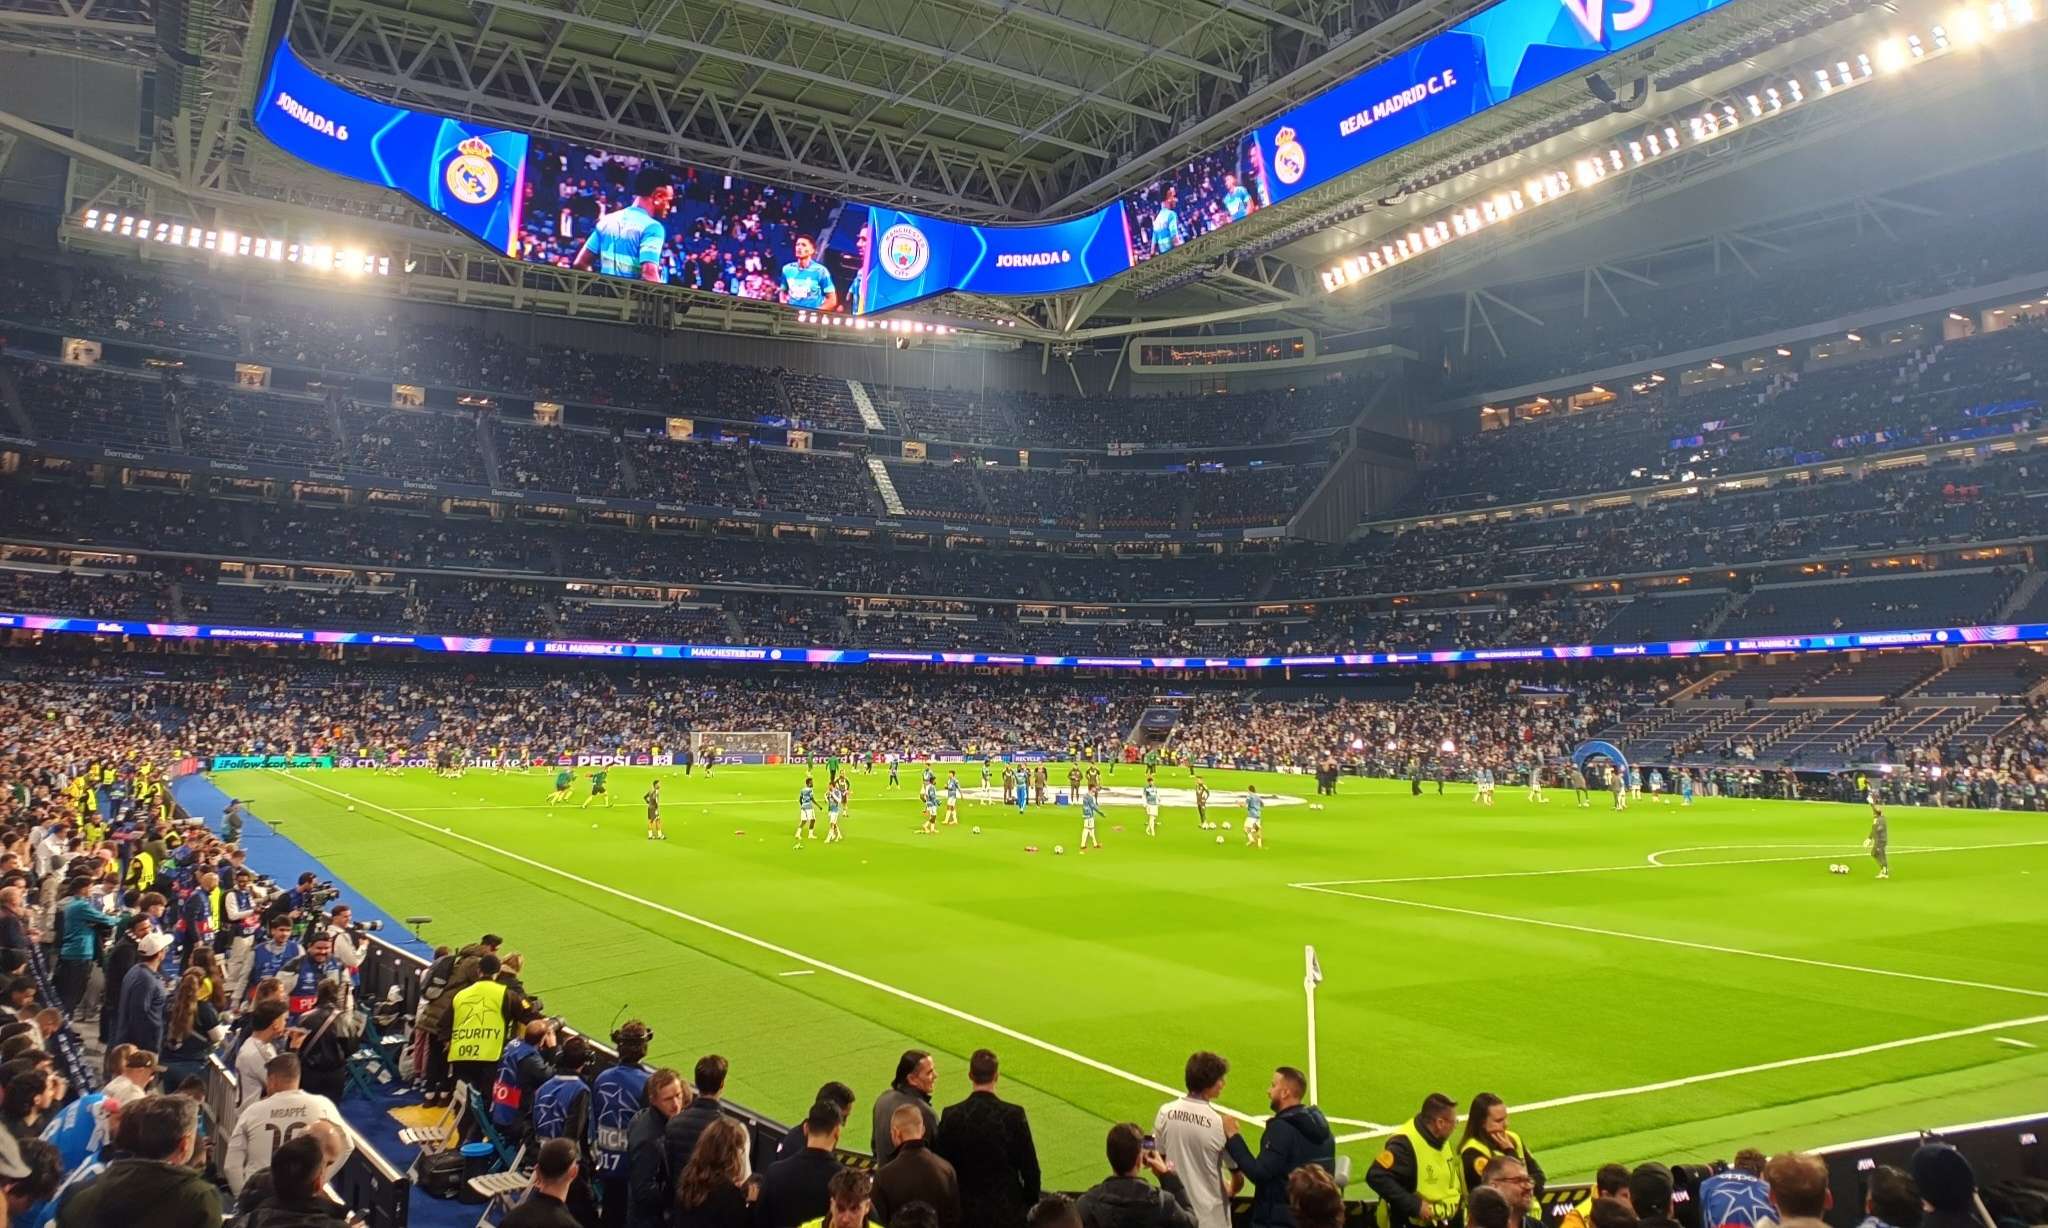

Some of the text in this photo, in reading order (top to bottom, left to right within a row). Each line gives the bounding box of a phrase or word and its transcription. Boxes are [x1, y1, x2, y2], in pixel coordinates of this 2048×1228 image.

[1340, 110, 1373, 136] REAL
[1373, 83, 1427, 121] MADRID
[276, 92, 349, 141] JORNADA 6
[996, 250, 1071, 268] JORNADA 6
[545, 643, 568, 652] REAL
[569, 644, 605, 653] MADRID
[691, 648, 746, 657] MANCHESTER
[578, 755, 631, 766] PEPSI
[713, 756, 743, 765] PS5
[450, 1028, 501, 1041] ECURITY
[458, 1044, 480, 1057] 092
[270, 1105, 307, 1119] MBAPPÉ
[1167, 1109, 1212, 1128] CARBONES
[598, 1128, 628, 1148] ITCH
